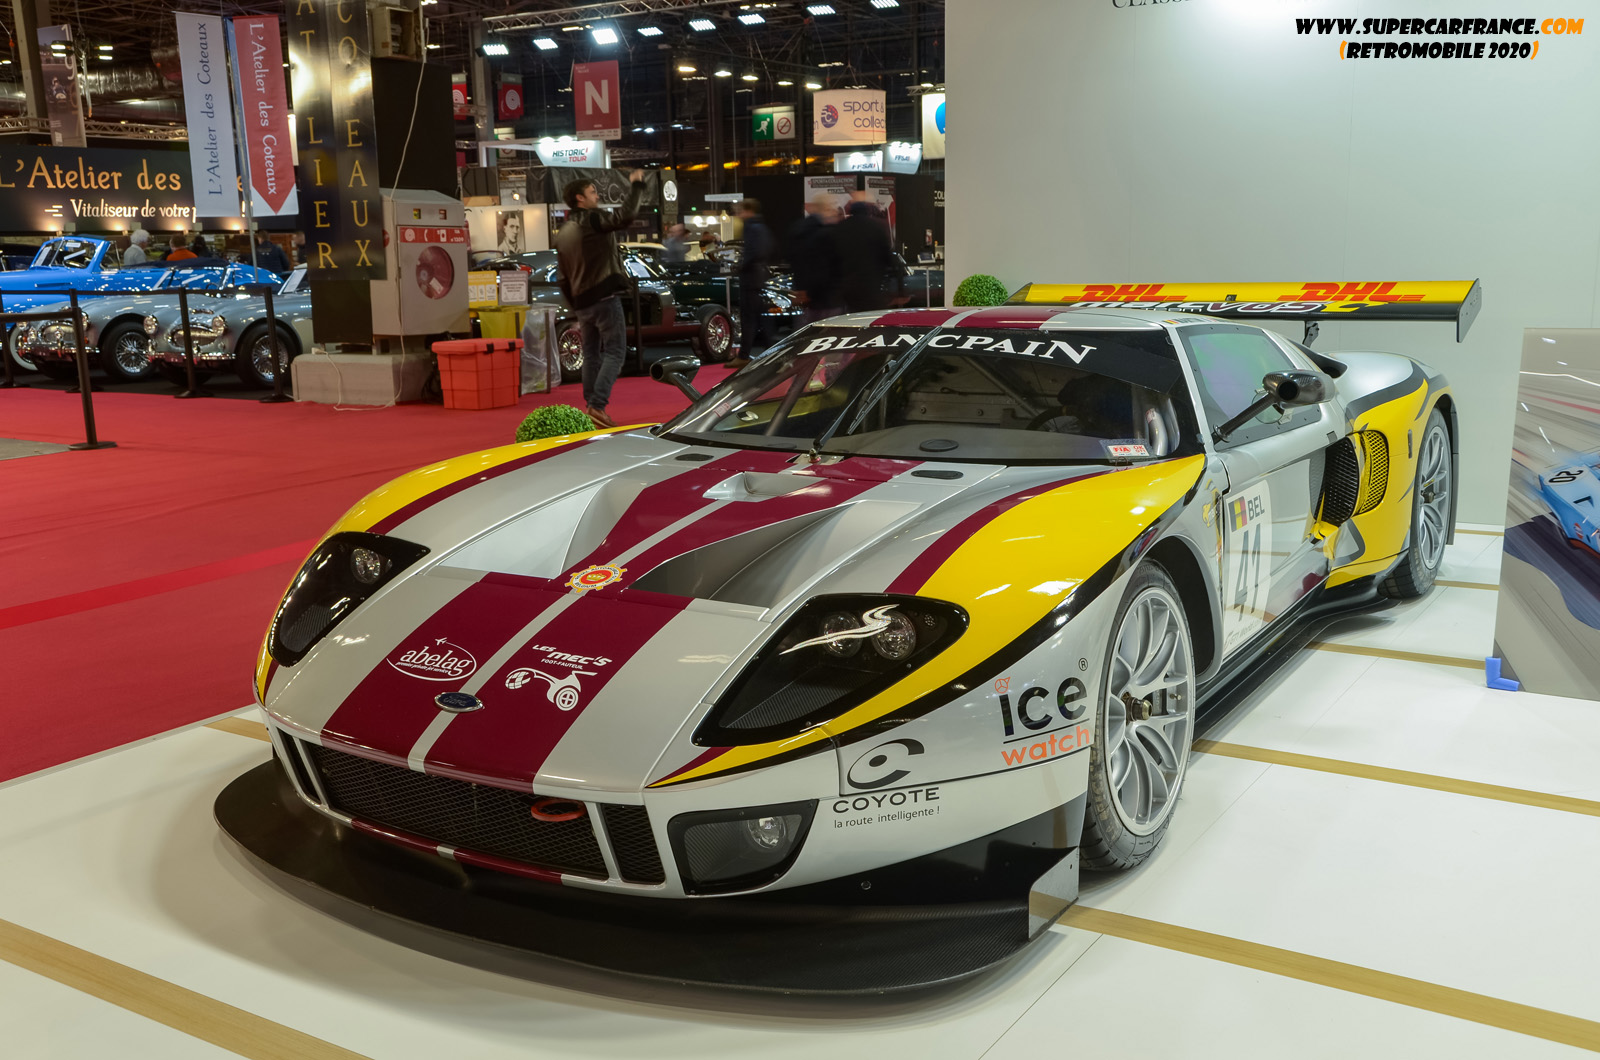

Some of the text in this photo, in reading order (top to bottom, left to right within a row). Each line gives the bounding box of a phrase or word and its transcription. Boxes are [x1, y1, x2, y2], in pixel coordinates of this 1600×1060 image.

[196, 22, 222, 195] L'Atelier des Coteaux
[249, 23, 277, 195] L'Atelier des Coteaux
[584, 79, 610, 115] N
[843, 99, 879, 115] sport
[552, 148, 585, 157] HISTORIC
[568, 155, 587, 163] TOUR
[136, 158, 182, 191] des
[70, 198, 138, 218] Vitaliseur
[140, 198, 156, 218] de
[159, 203, 190, 218] votre
[1079, 284, 1166, 302] DHL
[1298, 282, 1400, 302] DHL
[797, 333, 1097, 364] BLANCPAIN
[1247, 494, 1266, 521] BEL
[1233, 522, 1262, 622] 41
[400, 645, 473, 676] abelag
[532, 644, 557, 652] LES
[547, 651, 613, 667] MEC'S
[540, 658, 584, 670] FOOT-FAUTEUIL
[994, 676, 1088, 738] ice
[1001, 725, 1091, 767] watch
[832, 786, 940, 814] COYOTE
[834, 819, 843, 829] la
[845, 817, 873, 828] route
[878, 807, 934, 823] intelligente
